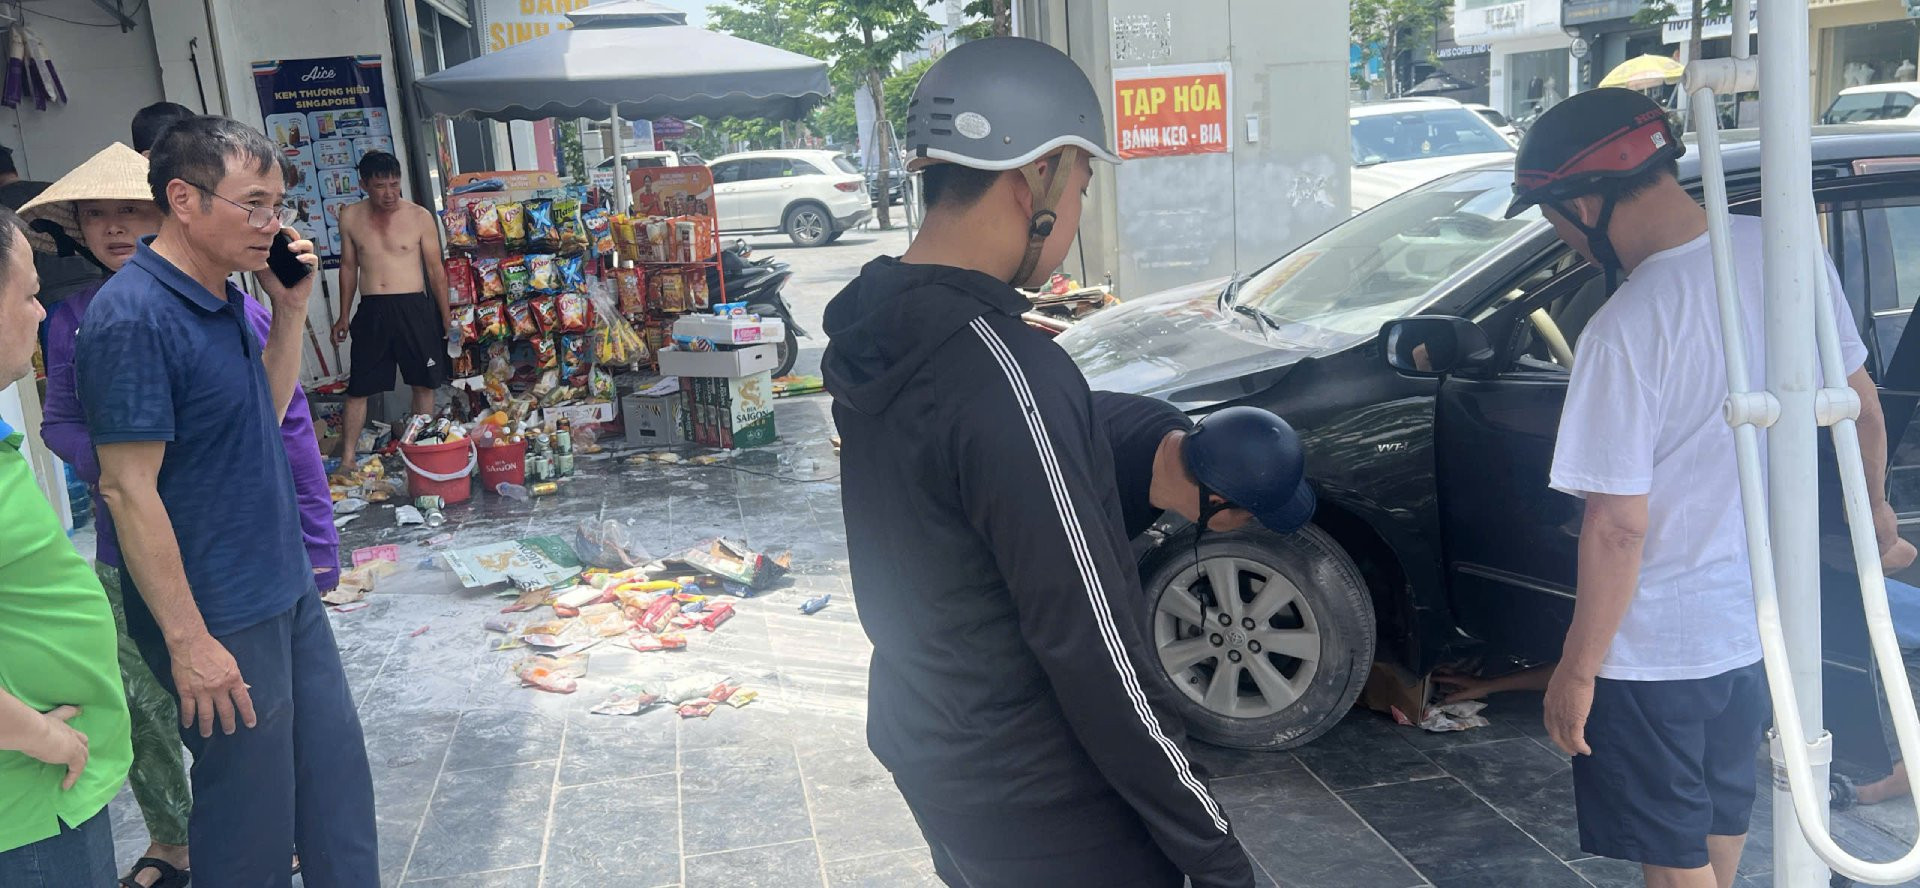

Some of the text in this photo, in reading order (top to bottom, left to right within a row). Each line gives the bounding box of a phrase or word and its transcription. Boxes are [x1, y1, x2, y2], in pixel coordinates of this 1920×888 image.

[1452, 46, 1473, 56] COFFEE
[301, 65, 337, 82] Aice
[274, 91, 298, 101] KEM
[299, 87, 344, 98] THƯƠNG
[1120, 79, 1222, 121] TẠP HÓA
[295, 96, 356, 109] SINGAPORE
[1122, 124, 1159, 150] BÁNH
[1162, 126, 1188, 150] KẸO
[1200, 123, 1222, 145] BIA
[736, 410, 769, 423] SAIGON
